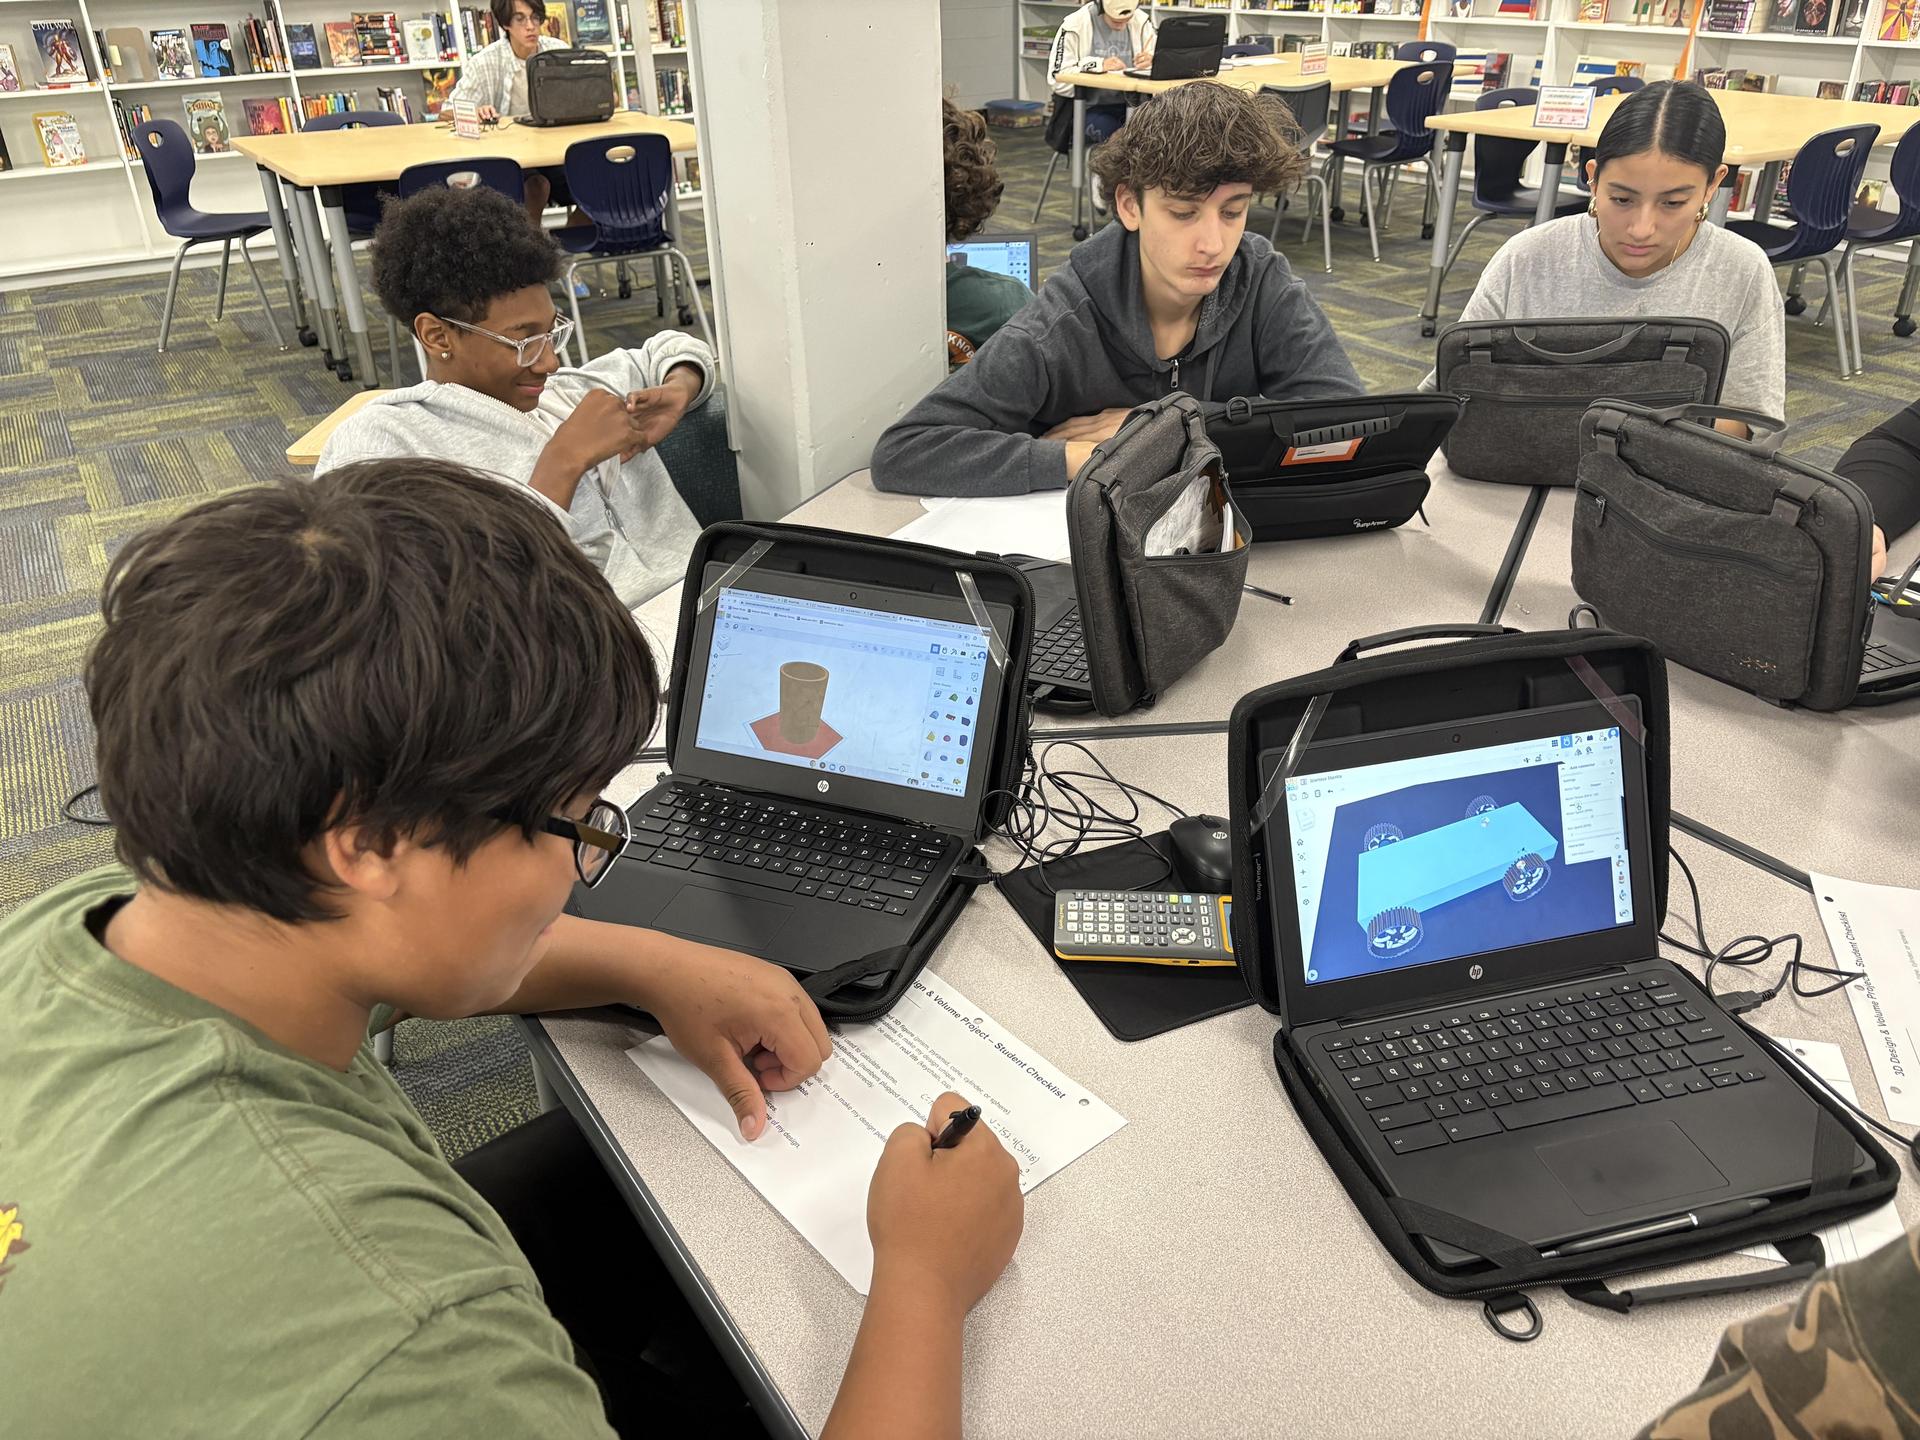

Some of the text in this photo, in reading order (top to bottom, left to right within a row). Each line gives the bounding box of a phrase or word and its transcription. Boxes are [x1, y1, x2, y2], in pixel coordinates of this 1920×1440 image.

[1838, 911, 1856, 943] Checklist
[1851, 942, 1865, 968] Student
[1864, 974, 1877, 1000] Projec
[1872, 1000, 1886, 1028] Volume
[899, 1024, 914, 1037] figure
[844, 1038, 857, 1048] used
[860, 1052, 880, 1069] calculate
[883, 1032, 896, 1043] used
[899, 1046, 911, 1055] real
[909, 1053, 918, 1061] life
[902, 1037, 916, 1048] make
[922, 1054, 939, 1068] design
[933, 995, 960, 1018] Volume
[960, 1016, 990, 1040] Project
[994, 1042, 1027, 1068] Student
[1026, 1067, 1065, 1098] Checklist
[1884, 1034, 1900, 1065] Design
[838, 1057, 855, 1071] design
[1893, 1065, 1904, 1077] 3D
[878, 1080, 900, 1098] plugged
[898, 1097, 908, 1106] into
[838, 1097, 852, 1110] make
[851, 1109, 860, 1117] my
[859, 1117, 876, 1132] design
